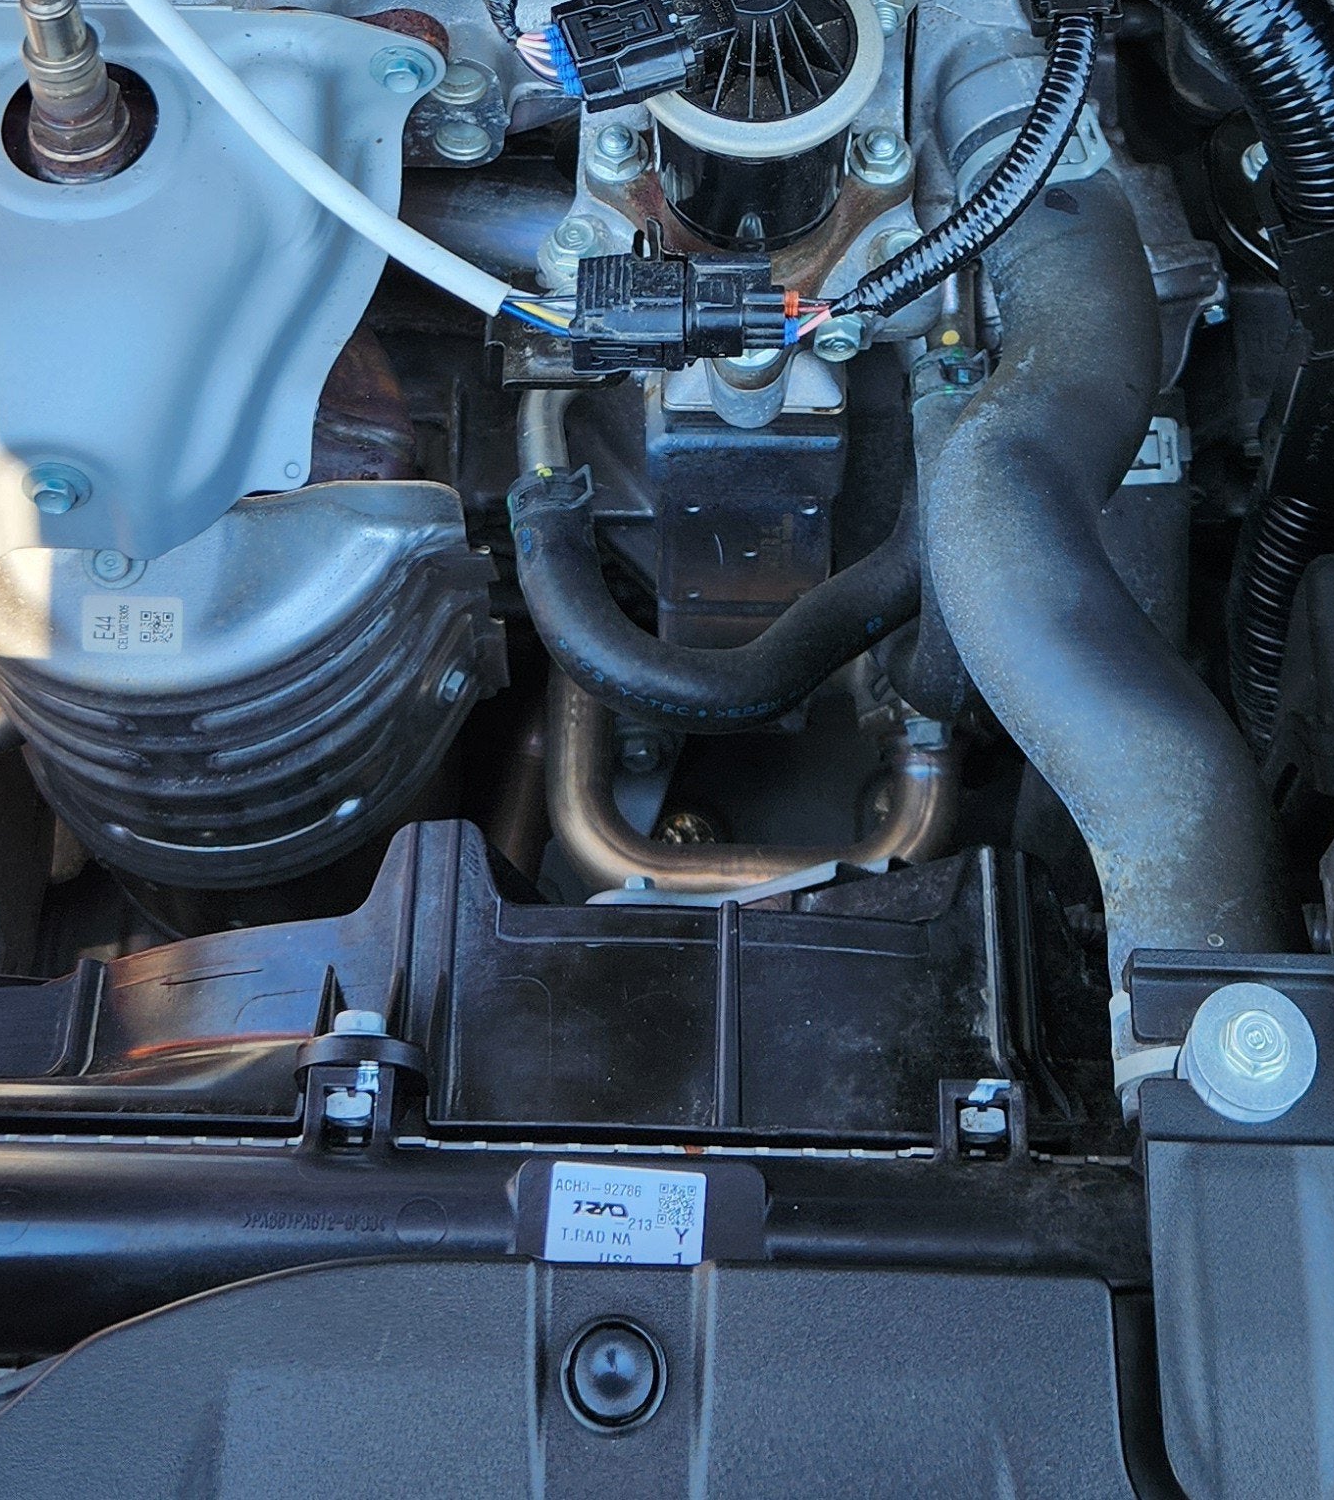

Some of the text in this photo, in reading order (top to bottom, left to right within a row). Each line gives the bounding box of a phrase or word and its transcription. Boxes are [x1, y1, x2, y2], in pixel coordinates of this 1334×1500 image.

[93, 616, 116, 640] E44
[561, 1227, 632, 1246] T.RAD NA
[674, 1227, 689, 1245] Y
